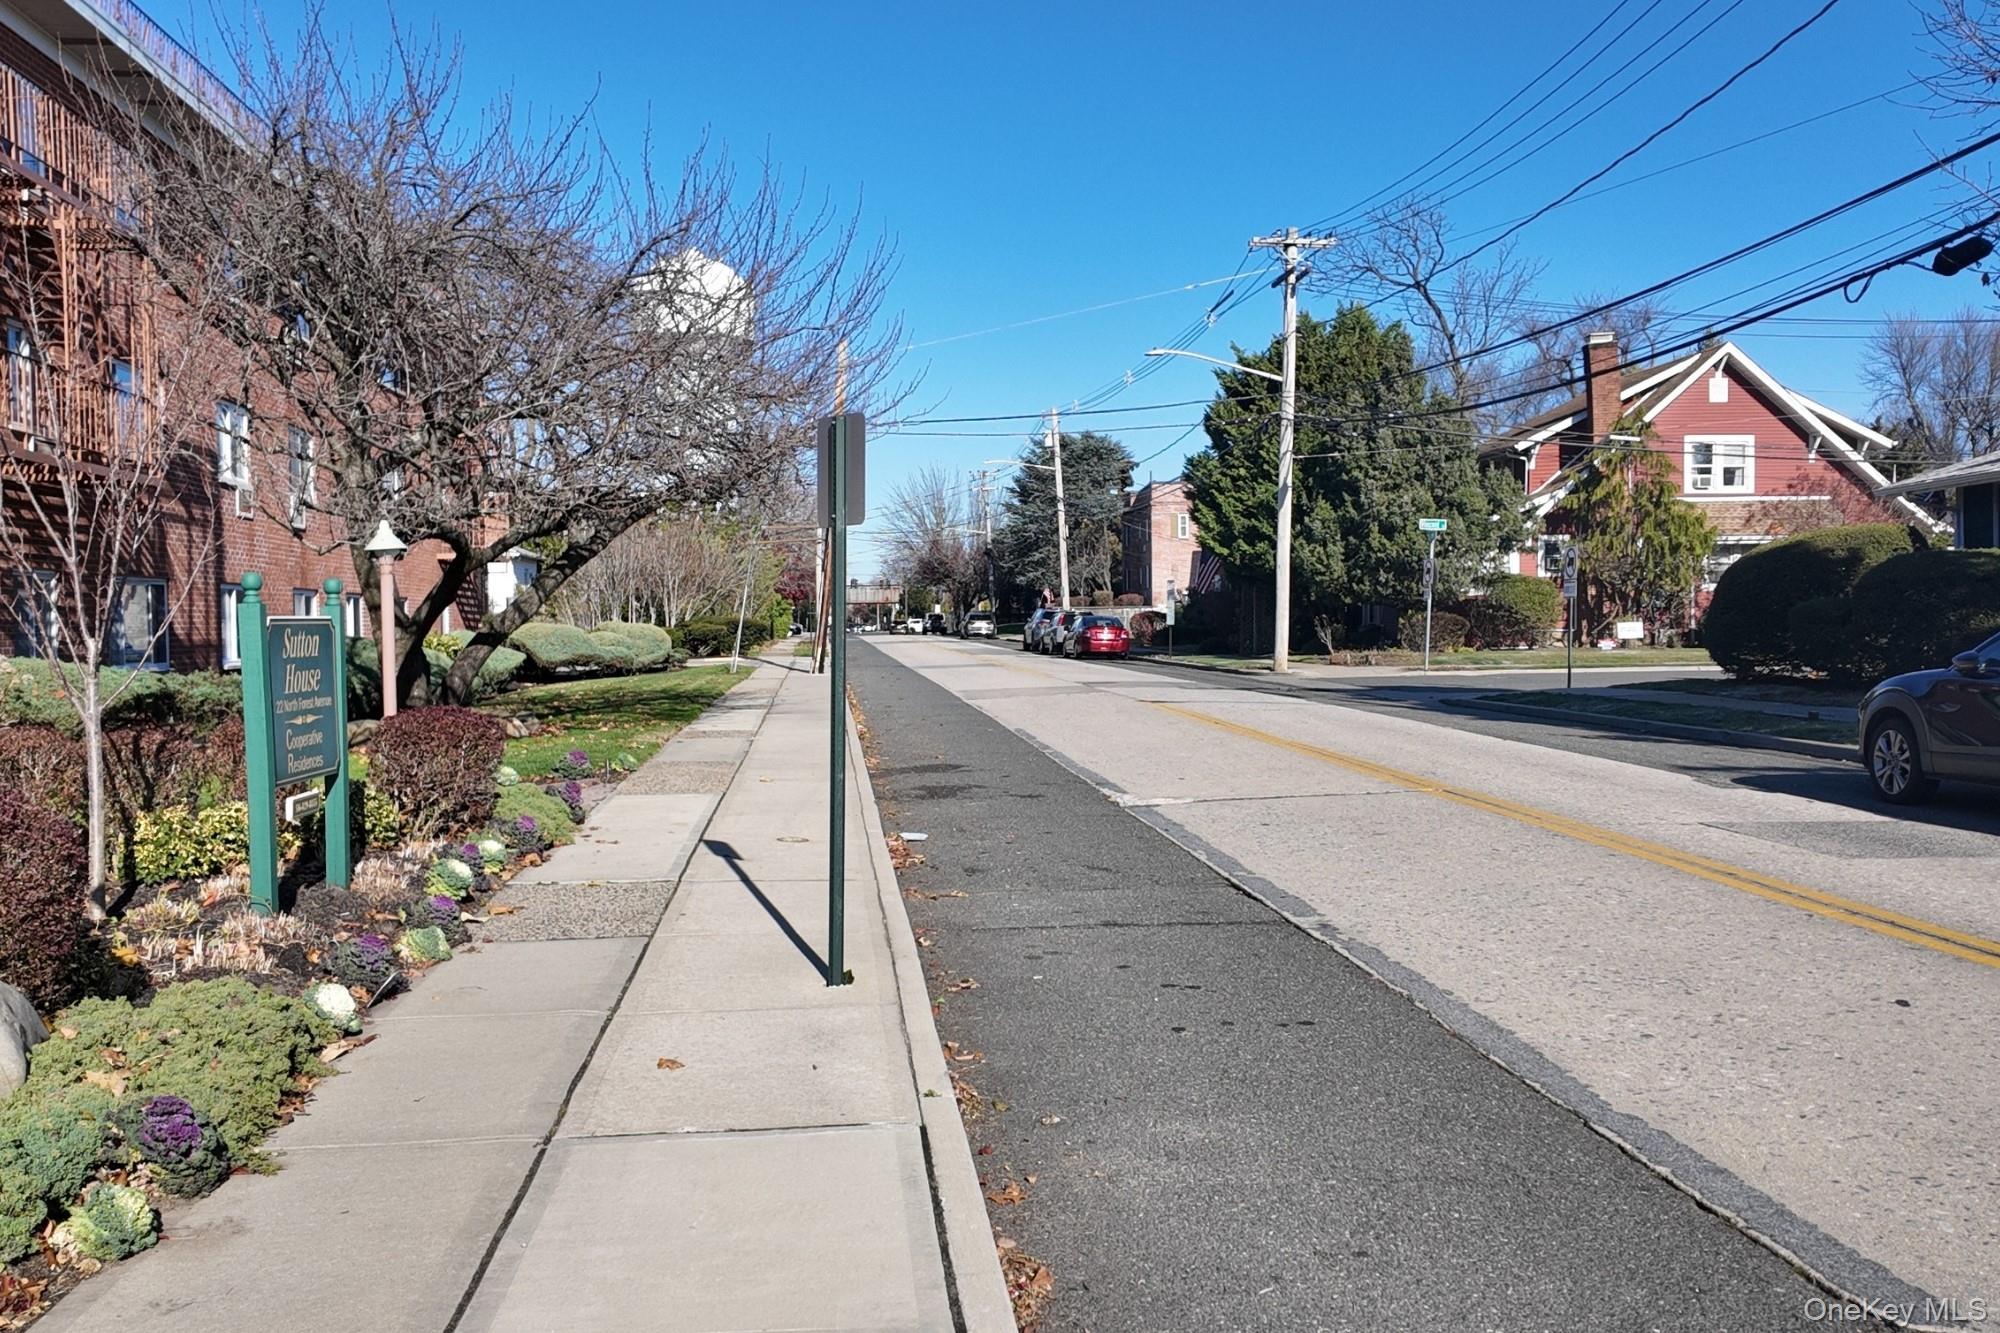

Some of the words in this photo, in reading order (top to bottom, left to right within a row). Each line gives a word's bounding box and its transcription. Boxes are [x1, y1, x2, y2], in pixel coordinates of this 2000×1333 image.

[282, 627, 319, 659] Sutton
[284, 663, 321, 694] House
[284, 699, 298, 713] North
[298, 697, 314, 711] Forest
[314, 695, 332, 709] Avenue
[286, 728, 323, 751] Cooperative
[287, 753, 324, 775] Residences
